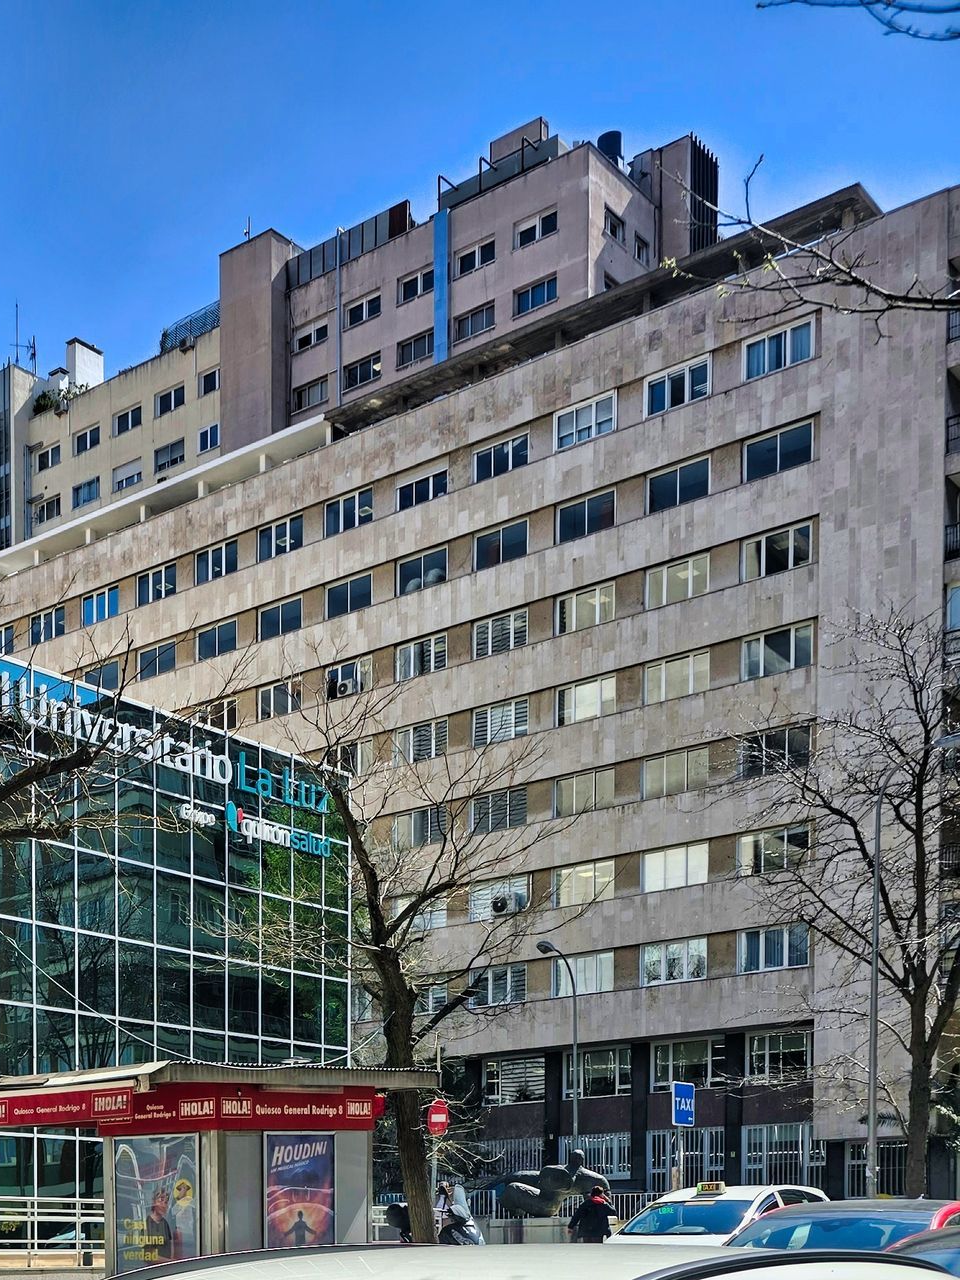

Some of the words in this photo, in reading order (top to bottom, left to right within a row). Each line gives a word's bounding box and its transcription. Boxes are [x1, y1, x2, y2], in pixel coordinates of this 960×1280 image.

[20, 678, 233, 785] Universitario
[238, 751, 272, 798] La
[283, 766, 330, 813] Luz
[14, 1108, 34, 1116] Quiosco
[36, 1105, 58, 1114] General
[59, 1104, 80, 1114] Rodrigo
[94, 1095, 128, 1111] ¡HOLA!
[181, 1100, 214, 1117] ¡HOLA!
[222, 1100, 251, 1115] ¡HOLA!
[255, 1104, 282, 1115] Quiosco
[284, 1104, 311, 1115] General
[312, 1104, 338, 1118] Rodrigo
[339, 1105, 343, 1115] 8
[347, 1102, 371, 1116] ¡HOLA!
[271, 1141, 327, 1168] HOUDINI
[123, 1231, 165, 1247] ninguna
[123, 1248, 159, 1261] verdad
